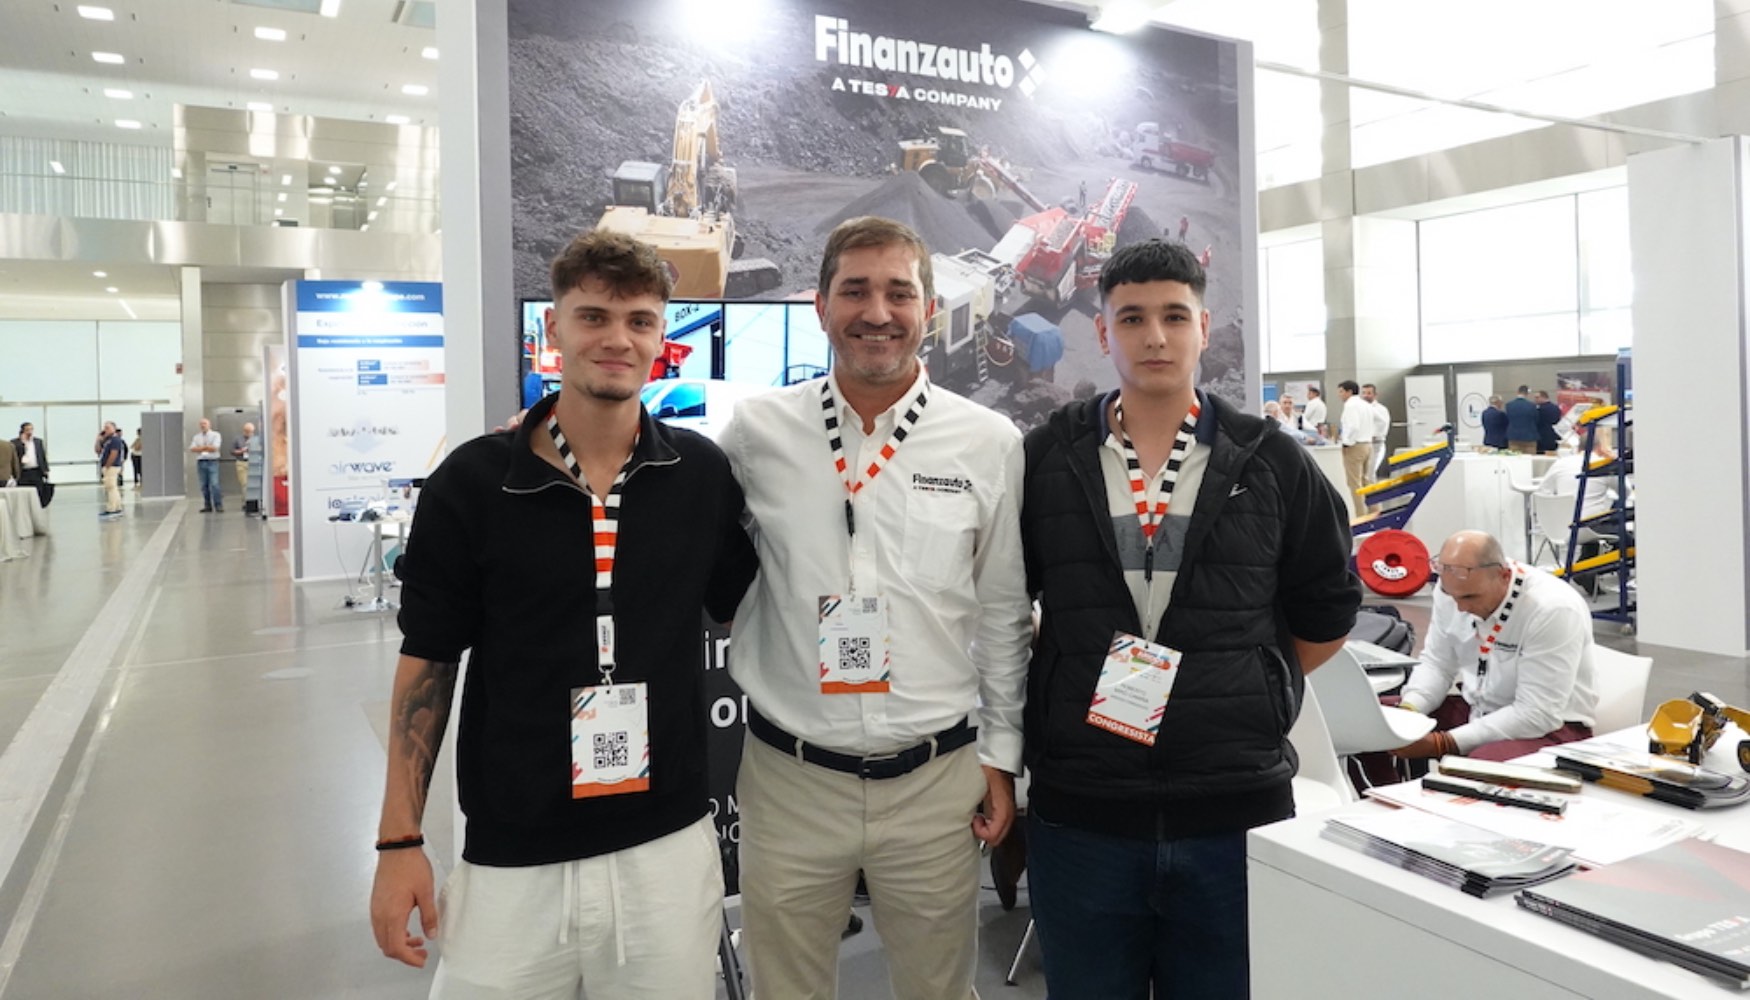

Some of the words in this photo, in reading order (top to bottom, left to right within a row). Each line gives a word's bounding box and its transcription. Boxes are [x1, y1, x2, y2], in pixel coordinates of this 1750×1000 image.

[815, 14, 1014, 88] Finanzauto
[832, 77, 845, 91] A
[913, 88, 1002, 112] COMPANY
[913, 473, 963, 488] Finanzauto
[1088, 714, 1155, 743] CONGRESISTA
